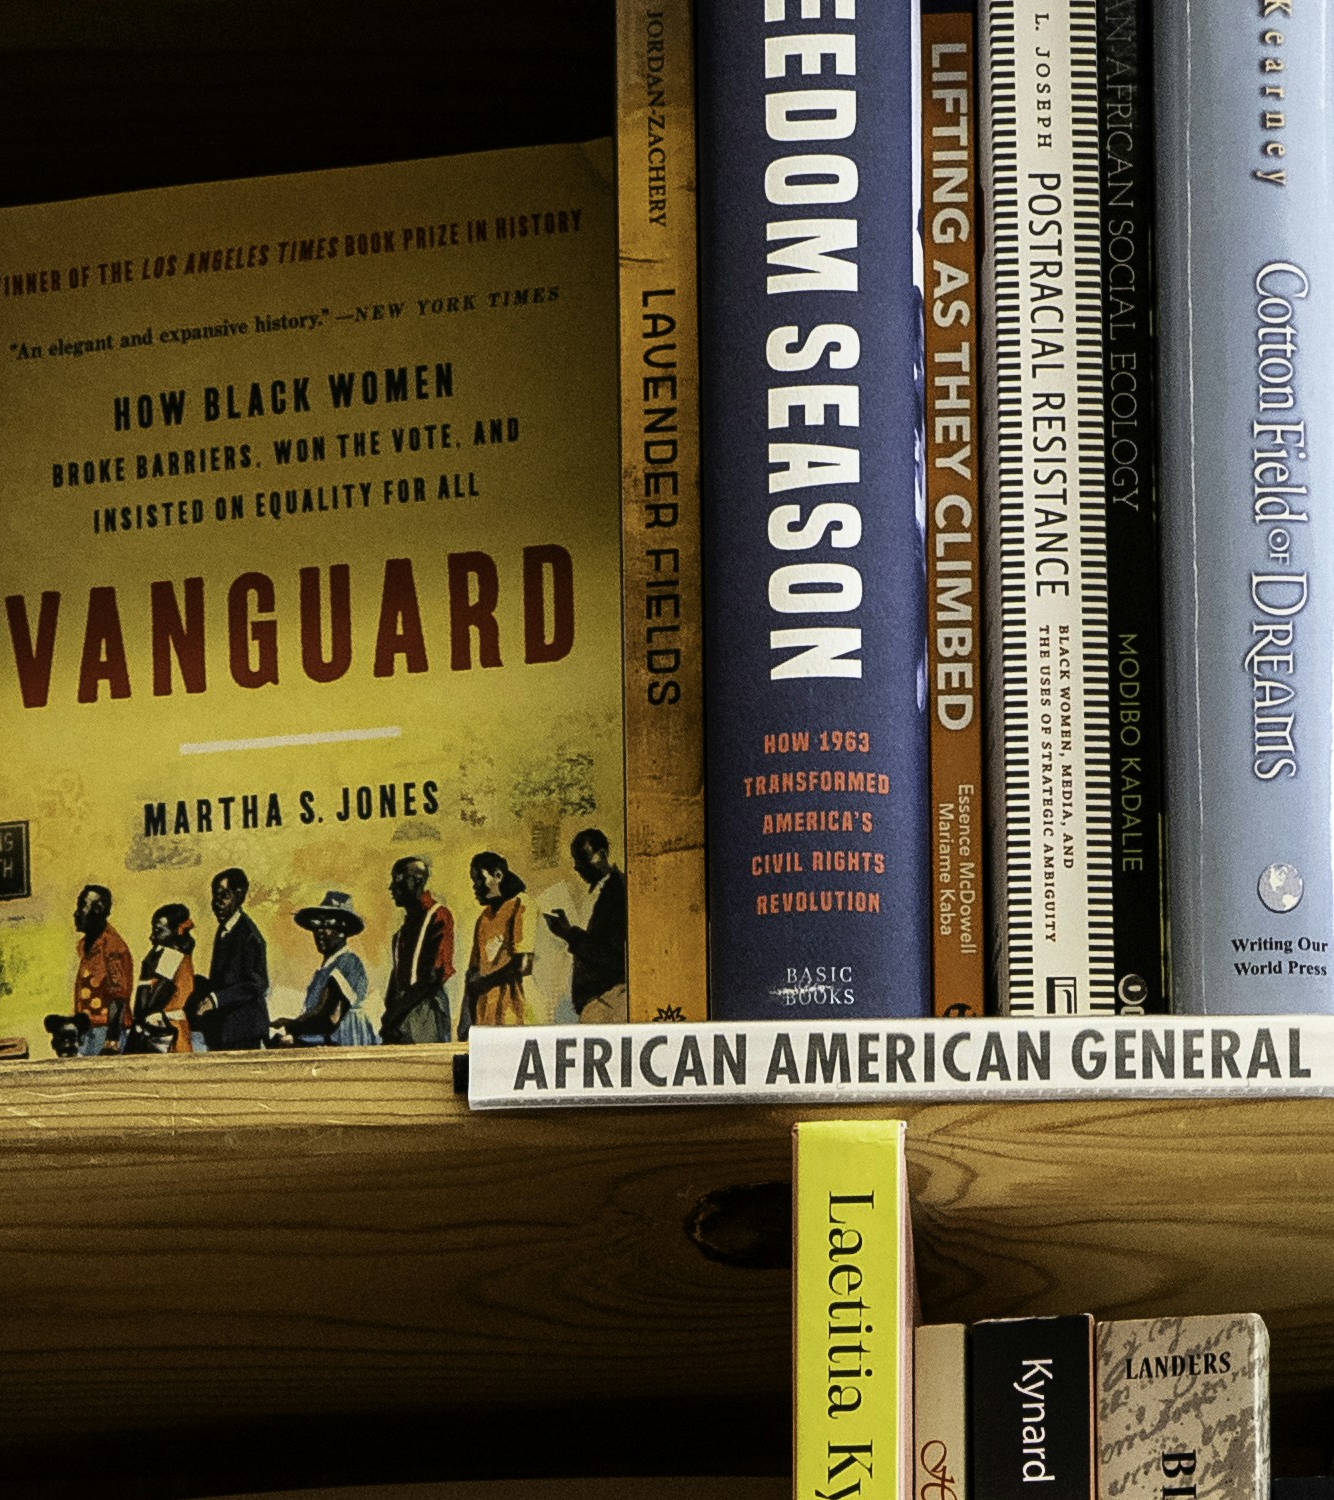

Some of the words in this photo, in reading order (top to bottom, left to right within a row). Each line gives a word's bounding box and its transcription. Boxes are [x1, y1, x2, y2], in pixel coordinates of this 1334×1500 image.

[766, 324, 862, 680] SEASON
[5, 543, 577, 709] VANGUARD
[143, 793, 281, 838] MARTHA
[300, 791, 323, 824] S.
[337, 781, 439, 821] JONES
[1230, 936, 1293, 954] Writing
[1297, 936, 1329, 952] Our
[1233, 960, 1283, 976] World
[1287, 960, 1328, 976] Press
[514, 1034, 746, 1090] AFRICAN
[766, 1031, 1050, 1084] AMERICAN
[1072, 1029, 1311, 1080] GENERAL
[828, 1194, 874, 1417] Laetitia
